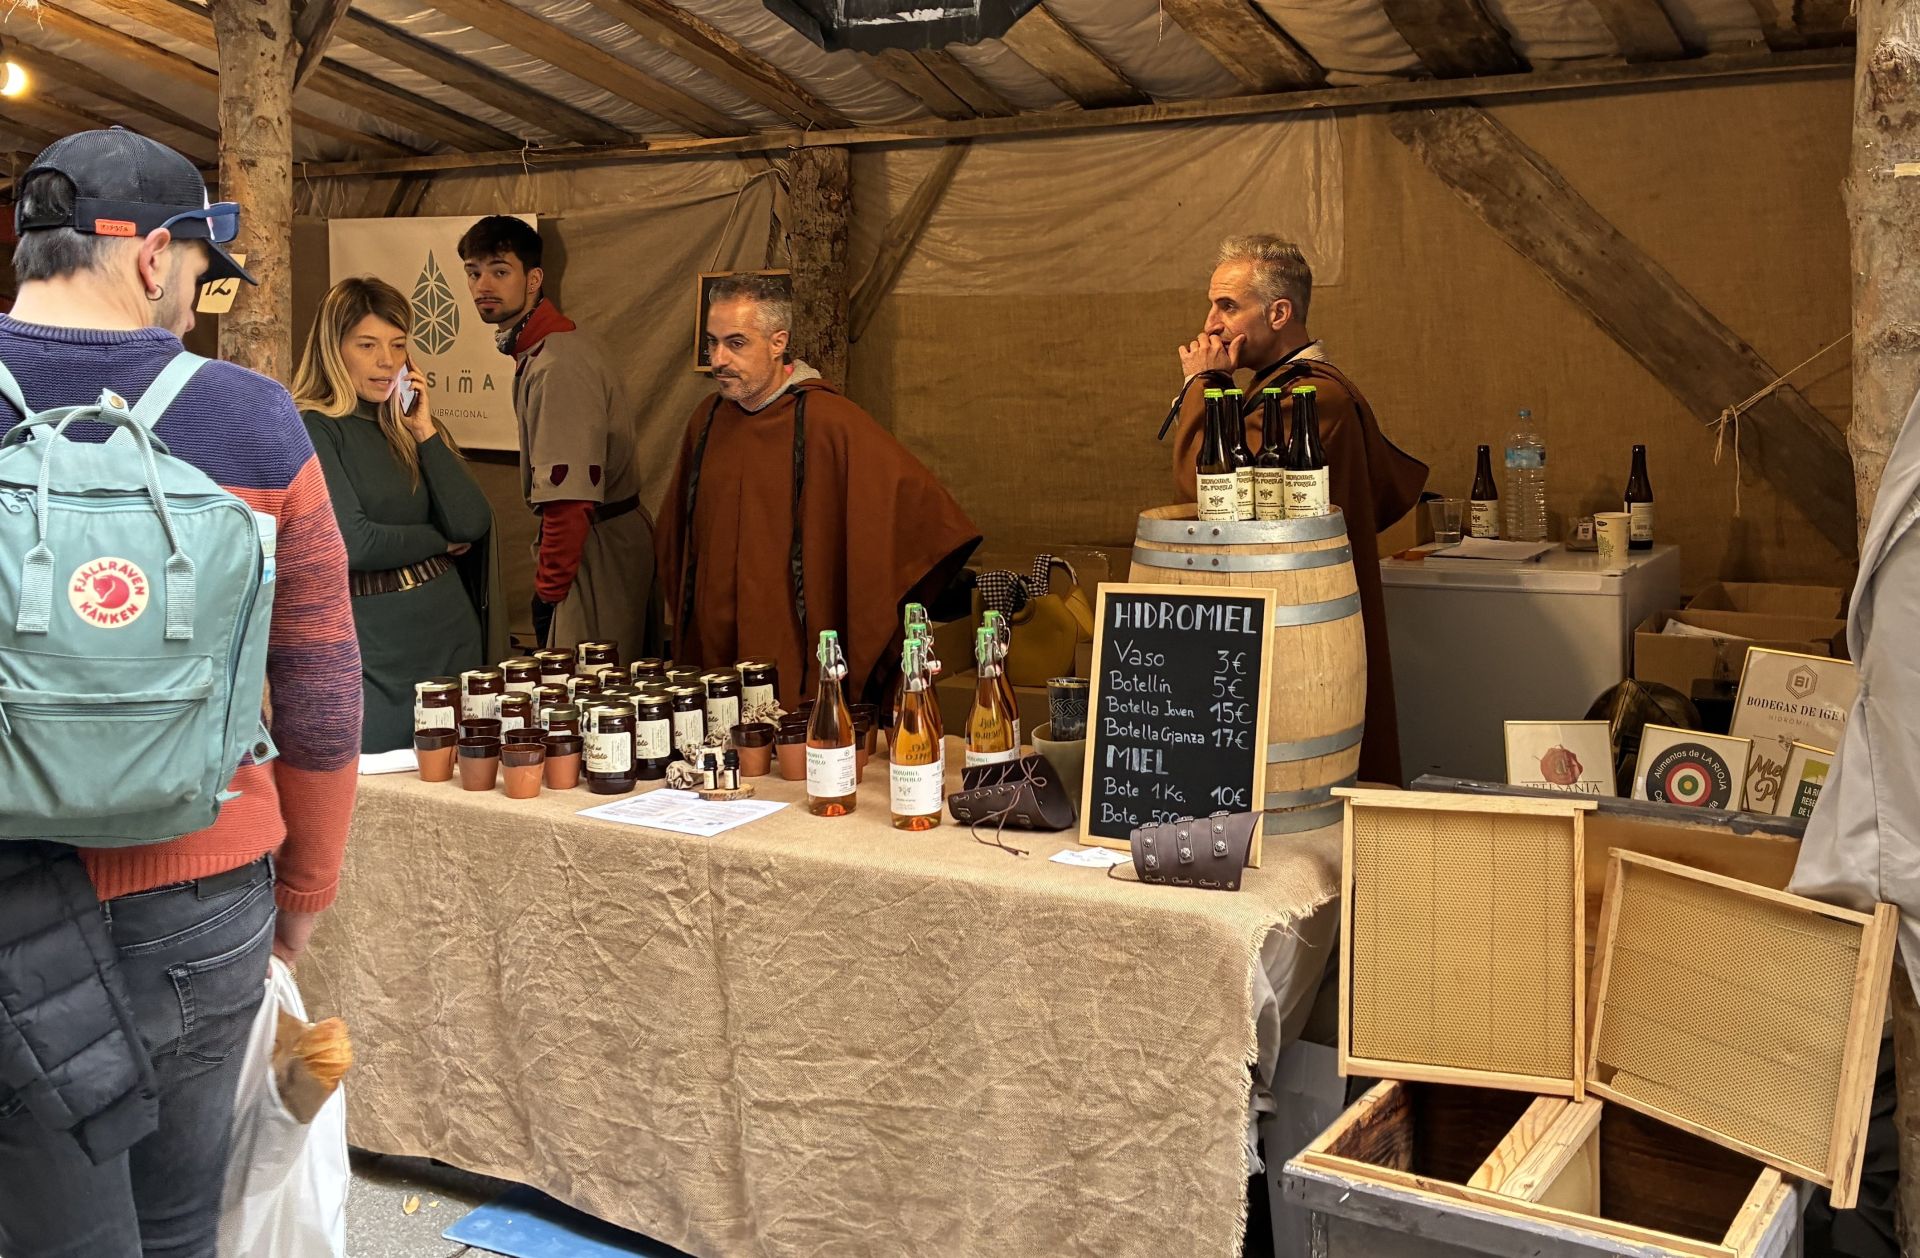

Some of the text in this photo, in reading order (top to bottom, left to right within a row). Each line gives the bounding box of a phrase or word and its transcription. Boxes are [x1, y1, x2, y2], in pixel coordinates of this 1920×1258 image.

[431, 408, 488, 419] VIBRACIONAL
[1114, 602, 1257, 634] HIDROMIEL
[1113, 639, 1247, 675] Vaso 3€
[1212, 676, 1245, 700] 5€
[1106, 696, 1253, 724] Botella Joven 15€
[1746, 696, 1798, 714] BODEGAS
[1800, 705, 1817, 717] DE
[1104, 718, 1159, 741] Botella
[1211, 728, 1249, 750] 17€
[1106, 744, 1169, 775] MIEL
[1654, 749, 1727, 791] Alimentos de LA RIOJA
[1104, 777, 1139, 798] Bote
[1210, 786, 1248, 807] 10€
[1101, 803, 1139, 824] Bote
